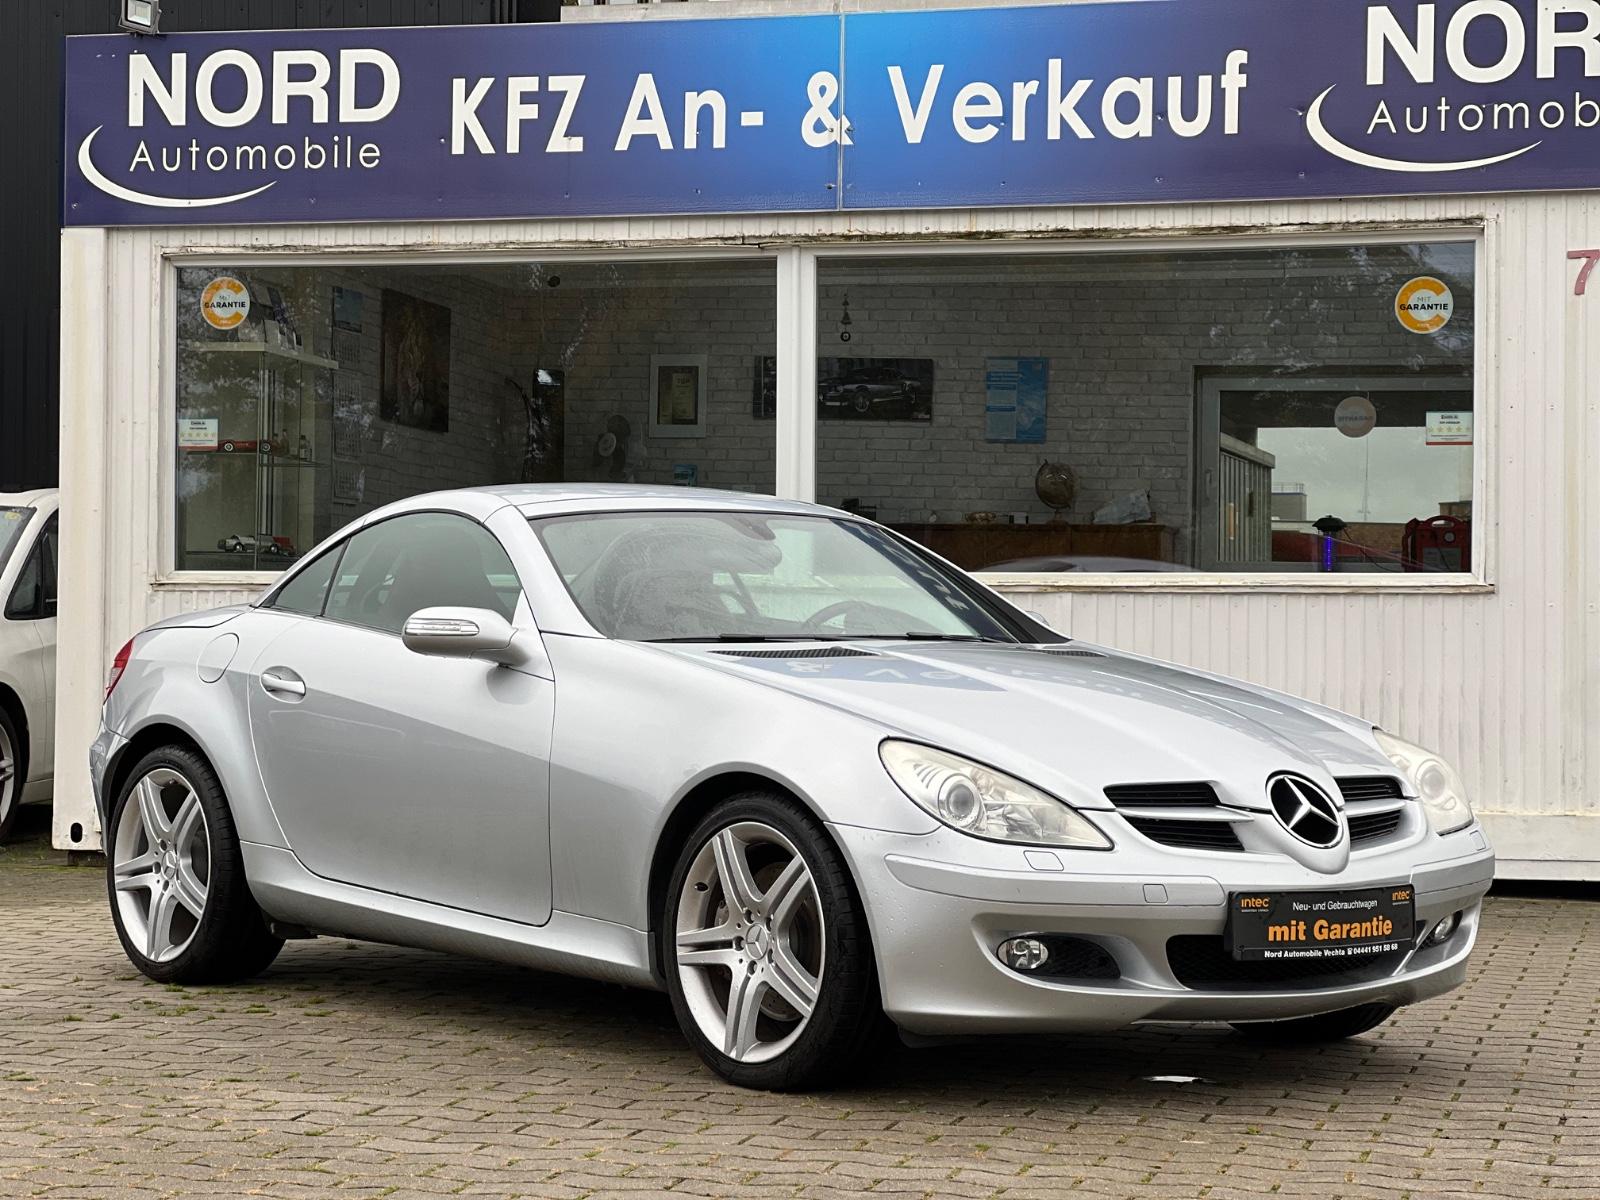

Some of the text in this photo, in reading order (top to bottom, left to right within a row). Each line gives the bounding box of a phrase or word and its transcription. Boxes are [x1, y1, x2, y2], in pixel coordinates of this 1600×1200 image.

[128, 49, 400, 127] NORD
[451, 50, 1248, 155] KFZ An- & Verkauf
[129, 136, 380, 172] Automobile
[1566, 249, 1600, 295] 7
[204, 301, 246, 309] GARANTIE
[1399, 303, 1449, 311] GARANTIE
[1292, 899, 1378, 911] Neu- und Gebrauchtwagen
[1268, 915, 1393, 942] mit Garantie
[1264, 950, 1283, 958] Nord
[1283, 949, 1323, 958] Automobile
[1323, 948, 1346, 957] Vechta
